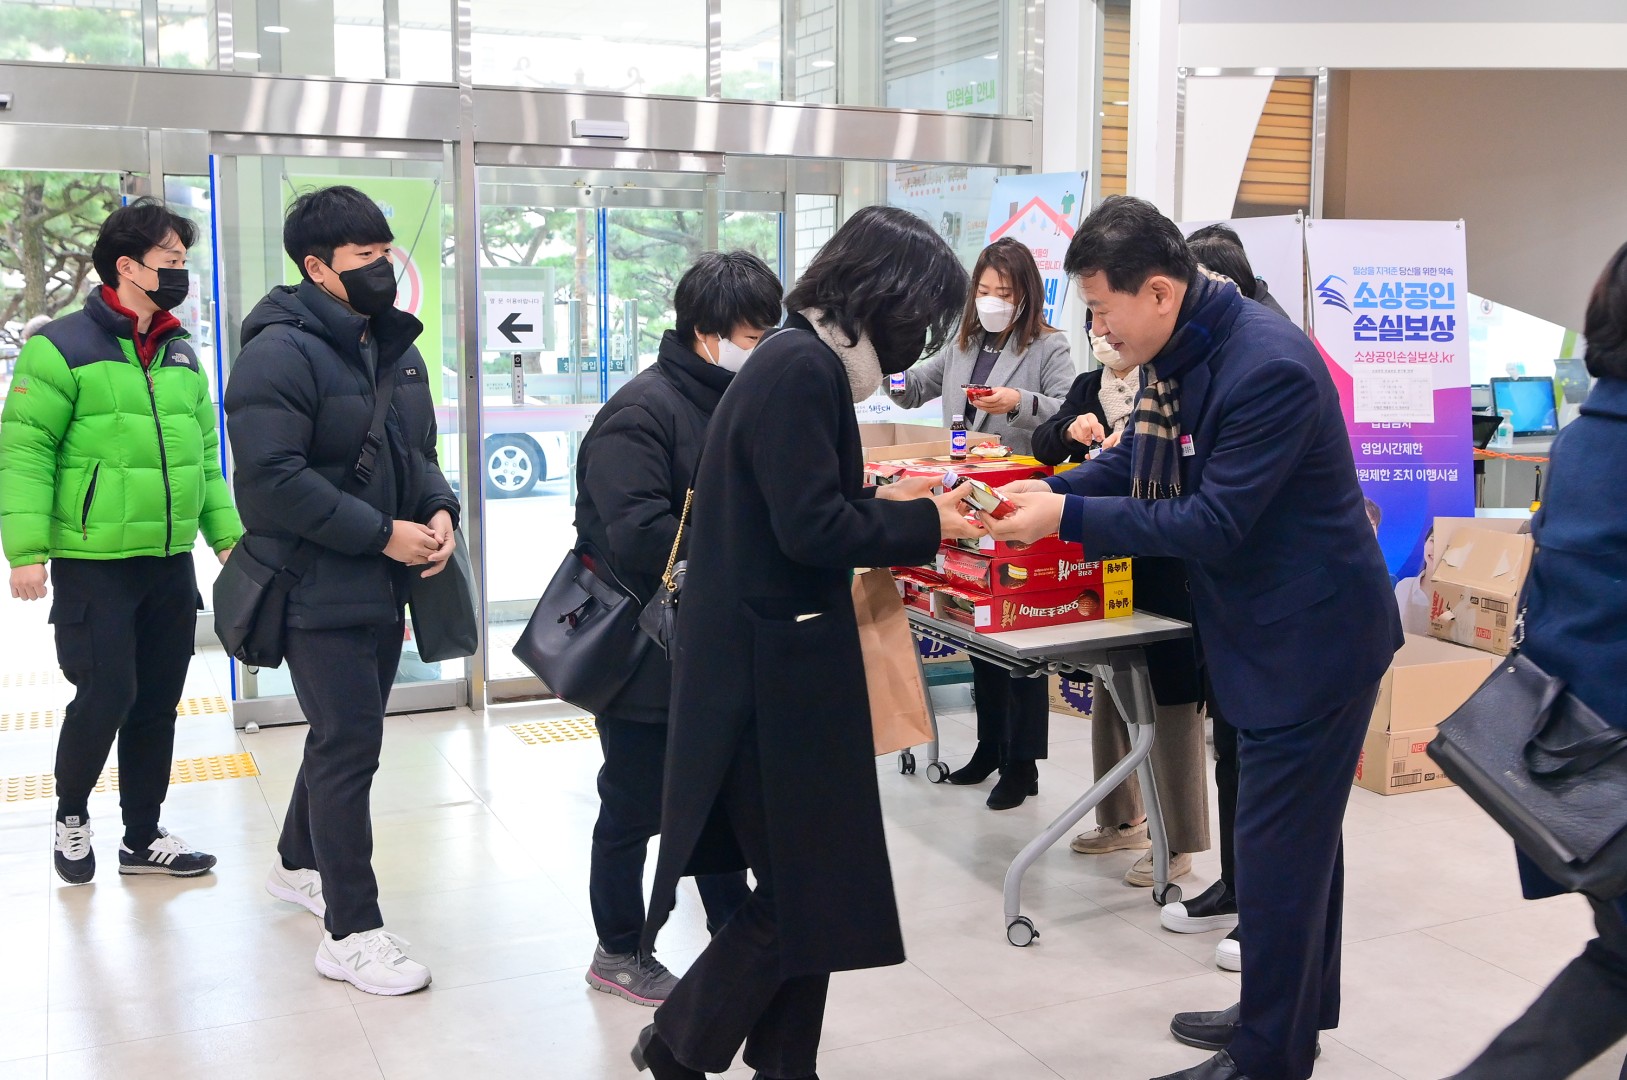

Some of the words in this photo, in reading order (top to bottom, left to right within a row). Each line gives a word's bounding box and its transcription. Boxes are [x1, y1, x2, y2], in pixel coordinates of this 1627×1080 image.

[946, 84, 974, 110] 민원실
[977, 79, 996, 103] 안내
[1030, 247, 1048, 259] 년들의
[1353, 266, 1374, 276] 일상을
[1376, 266, 1398, 276] 지켜준
[1399, 266, 1421, 276] 당신을
[1422, 266, 1437, 276] 위한
[1438, 266, 1454, 276] 약속
[1353, 281, 1455, 310] 소상공인
[1353, 314, 1456, 342] 손실보상
[1354, 350, 1455, 364] 소상공인손실보상.kr
[405, 368, 416, 376] K2
[1361, 442, 1423, 456] 영업시간제한
[1393, 468, 1414, 482] 조치
[1416, 468, 1459, 482] 이행시설
[1070, 561, 1100, 571] 초코파이
[1107, 562, 1128, 574] 실속형
[1077, 569, 1093, 577] 오리온
[1057, 599, 1079, 614] 오리온
[1108, 597, 1129, 610] 실속형
[1019, 603, 1057, 618] 초코파이
[1477, 627, 1491, 639] NEW
